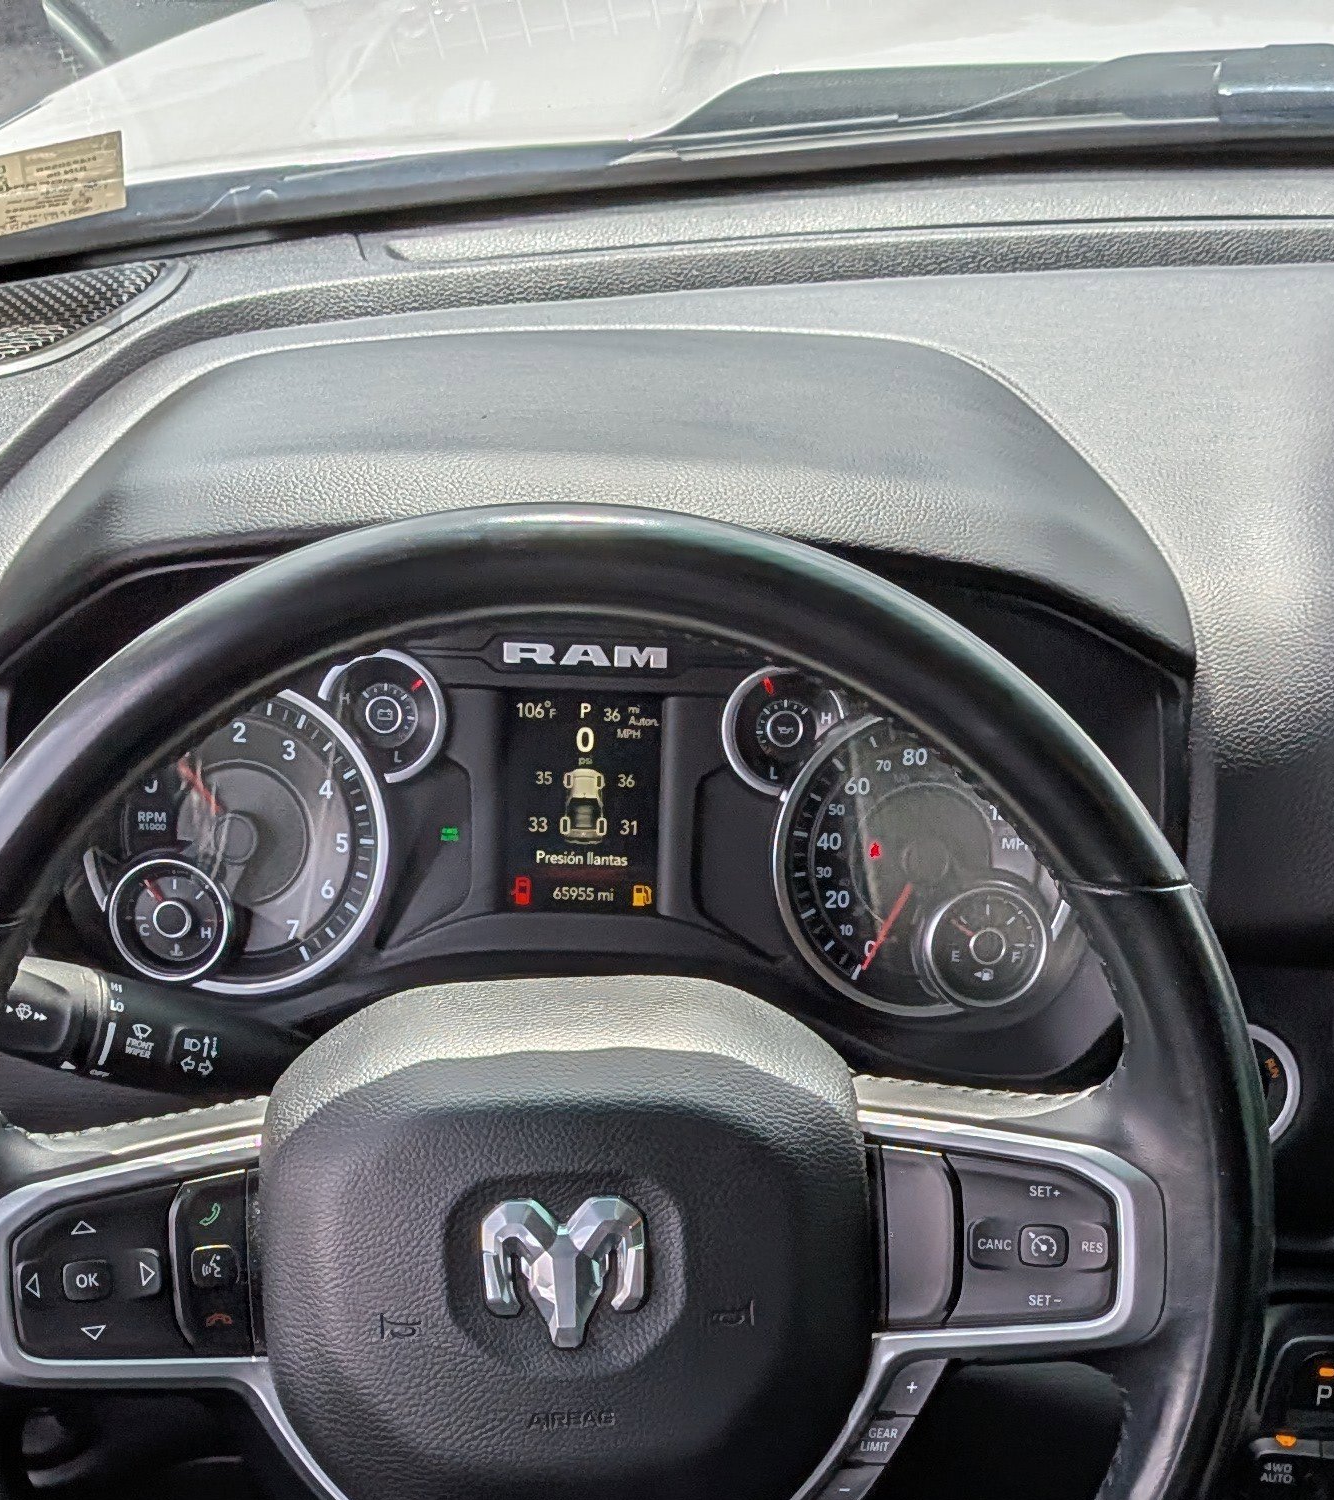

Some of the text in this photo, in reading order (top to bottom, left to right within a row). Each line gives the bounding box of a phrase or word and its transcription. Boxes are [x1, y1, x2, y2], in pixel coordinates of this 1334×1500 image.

[502, 641, 668, 669] RAM
[579, 702, 592, 719] P
[603, 708, 621, 722] 36
[820, 711, 833, 724] H
[232, 722, 248, 744] 2
[575, 726, 595, 753] 0
[616, 728, 642, 740] MPH
[281, 740, 297, 761] 3
[901, 747, 928, 766] 80
[875, 759, 893, 772] 70
[535, 771, 554, 785] 35
[768, 766, 779, 780] L
[617, 774, 636, 788] 36
[844, 776, 871, 795] 60
[318, 779, 334, 799] 4
[828, 803, 846, 816] 50
[137, 811, 167, 823] RPM
[528, 816, 549, 833] 33
[619, 819, 638, 836] 31
[335, 833, 350, 853] 5
[817, 832, 842, 851] 40
[535, 850, 629, 867] Presión llantas
[816, 866, 833, 879] 30
[321, 878, 336, 898] 6
[552, 886, 615, 902] 65955 mi
[825, 890, 850, 909] 20
[139, 923, 151, 937] C
[200, 926, 213, 940] H
[286, 918, 301, 940] 7
[839, 923, 854, 937] 10
[951, 950, 961, 963] E
[110, 999, 125, 1013] LO
[126, 1037, 155, 1051] FRONT
[125, 1047, 152, 1059] WIPER
[977, 1238, 1012, 1251] CANC
[1081, 1241, 1103, 1254] RES
[75, 1272, 100, 1289] OK
[526, 1410, 617, 1431] AIRBAG
[869, 1427, 898, 1439] GEAR
[860, 1440, 890, 1452] LIMIT
[1263, 1462, 1293, 1474] 4WD
[1260, 1473, 1294, 1484] AUTO
